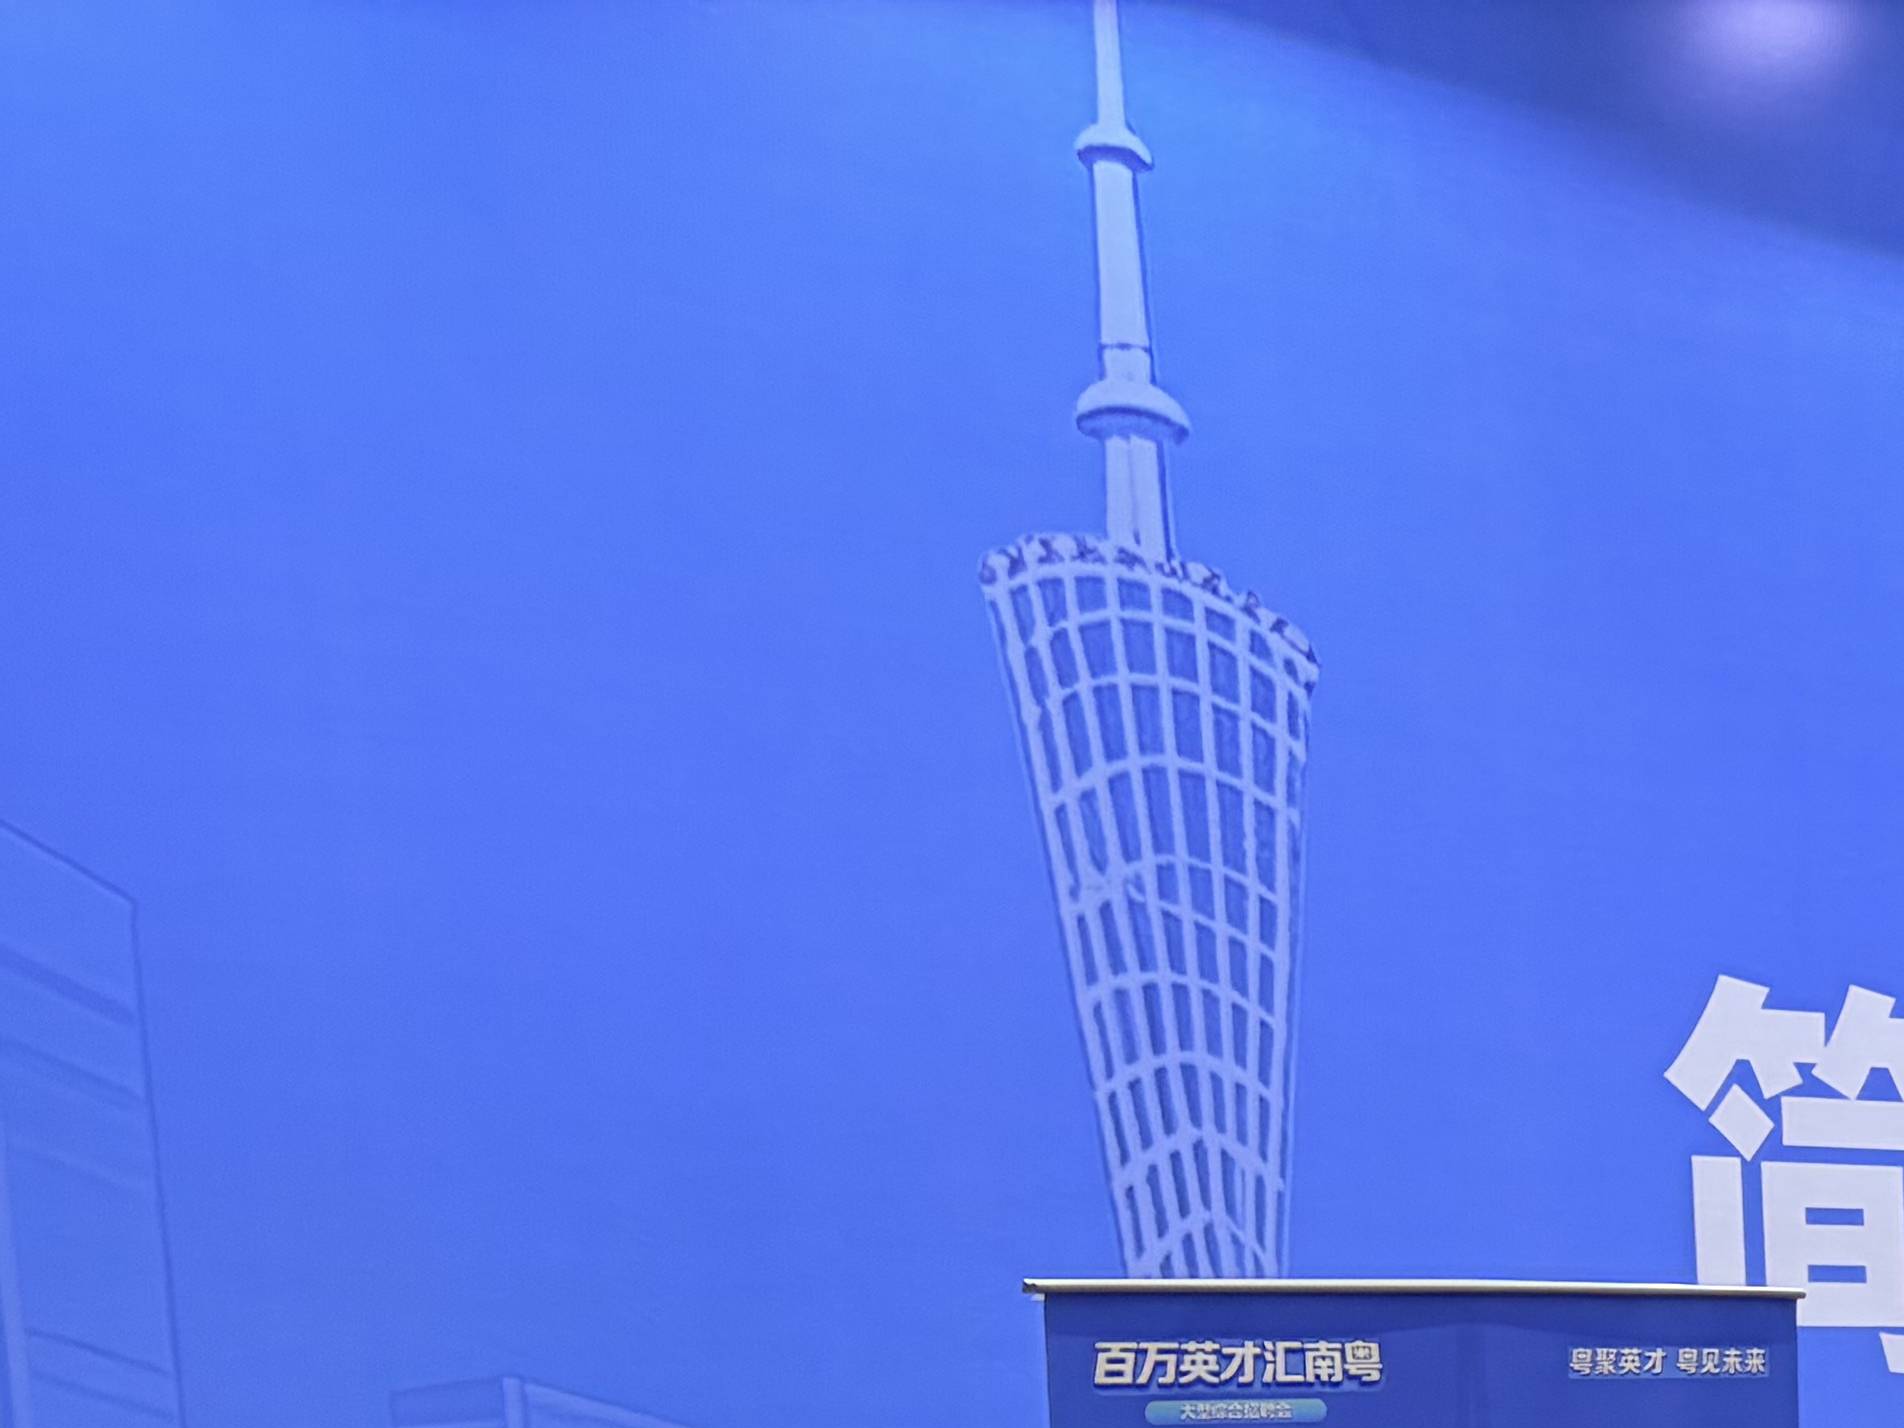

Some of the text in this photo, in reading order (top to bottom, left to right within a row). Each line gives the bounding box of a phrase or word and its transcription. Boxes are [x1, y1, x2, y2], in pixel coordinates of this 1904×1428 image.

[1094, 1340, 1382, 1386] 百万英才汇南粤
[1569, 1347, 1767, 1376] 粤聚英才 粤见未来
